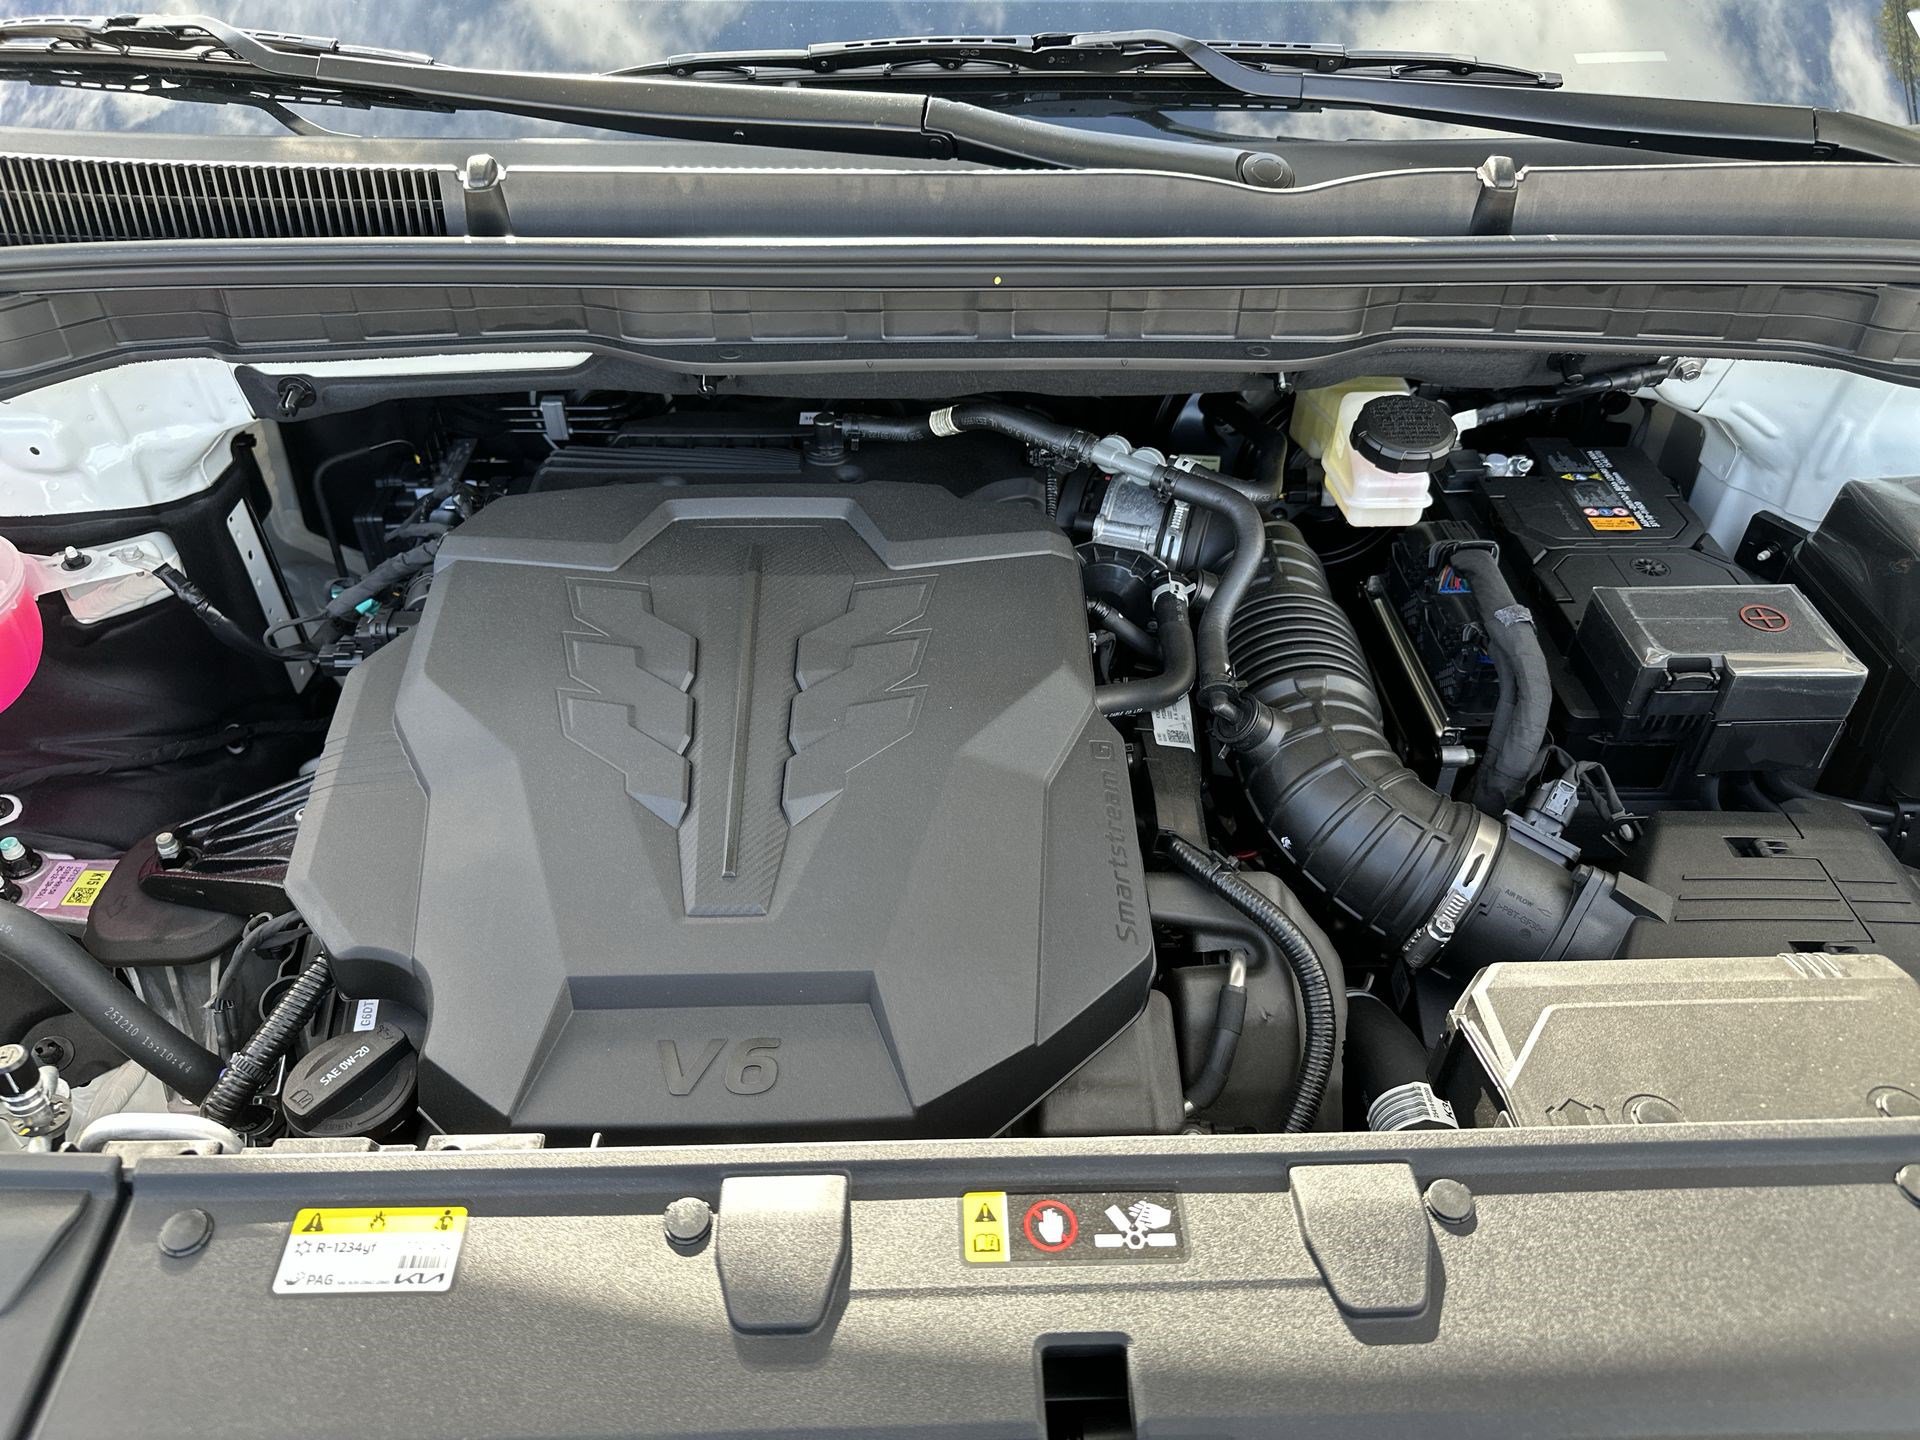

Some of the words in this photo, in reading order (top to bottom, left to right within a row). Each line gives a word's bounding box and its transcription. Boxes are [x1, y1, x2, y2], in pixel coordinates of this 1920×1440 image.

[1100, 768, 1140, 947] Smartstream
[87, 872, 106, 885] K15
[1504, 888, 1516, 898] AIR
[1515, 894, 1534, 907] FLOW
[360, 1000, 375, 1027] G6DT
[320, 1067, 342, 1087] SAE
[339, 1045, 370, 1071] 0W-20
[656, 1037, 783, 1097] V6
[306, 1274, 334, 1286] PAG
[393, 1272, 445, 1285] KIA
